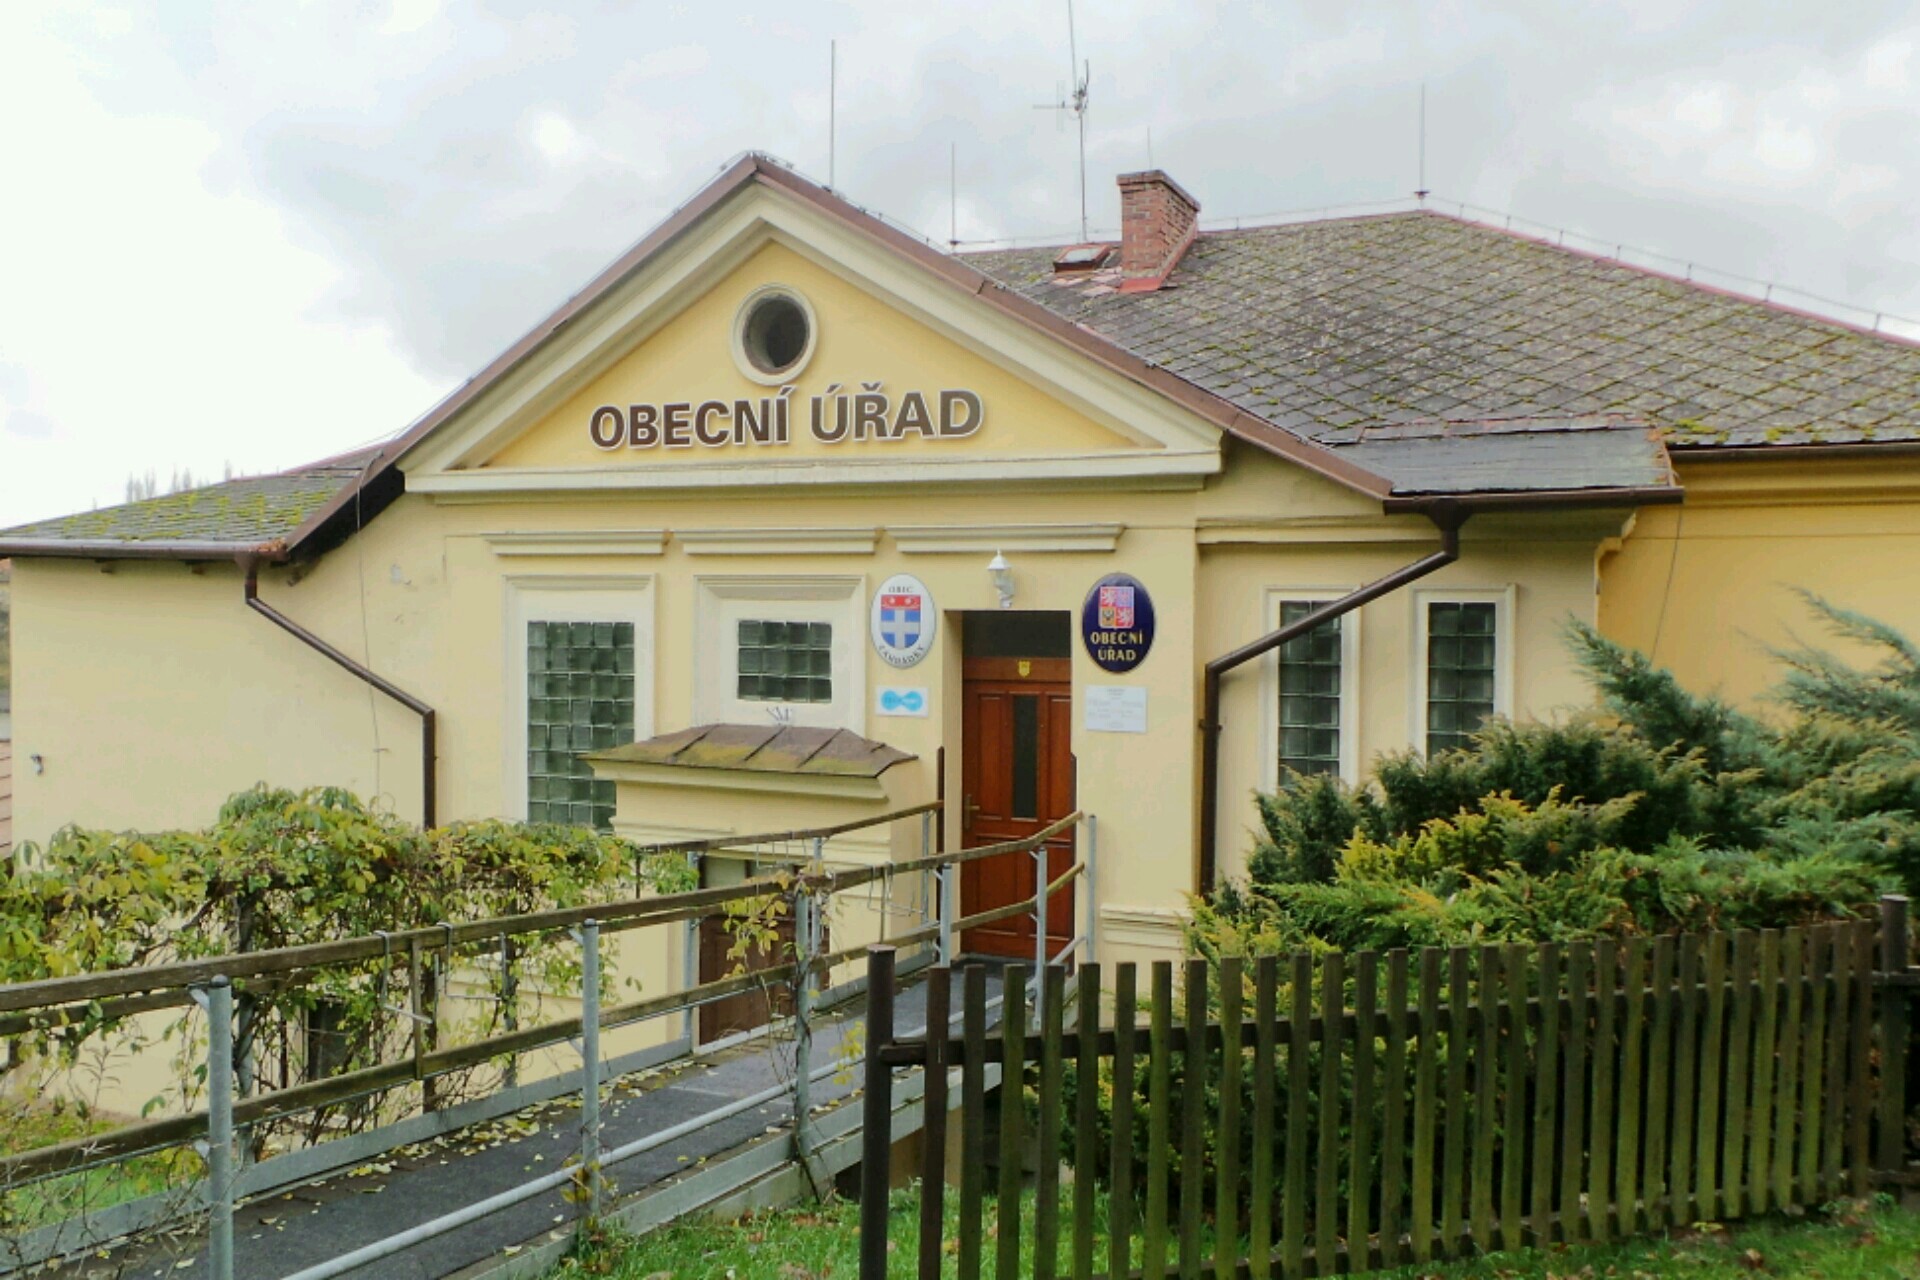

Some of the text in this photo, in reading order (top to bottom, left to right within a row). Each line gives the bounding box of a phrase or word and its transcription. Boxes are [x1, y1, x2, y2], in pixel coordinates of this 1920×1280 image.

[591, 380, 984, 450] OBECNÍ ÚŘAD
[1090, 629, 1143, 645] OBECNÍ
